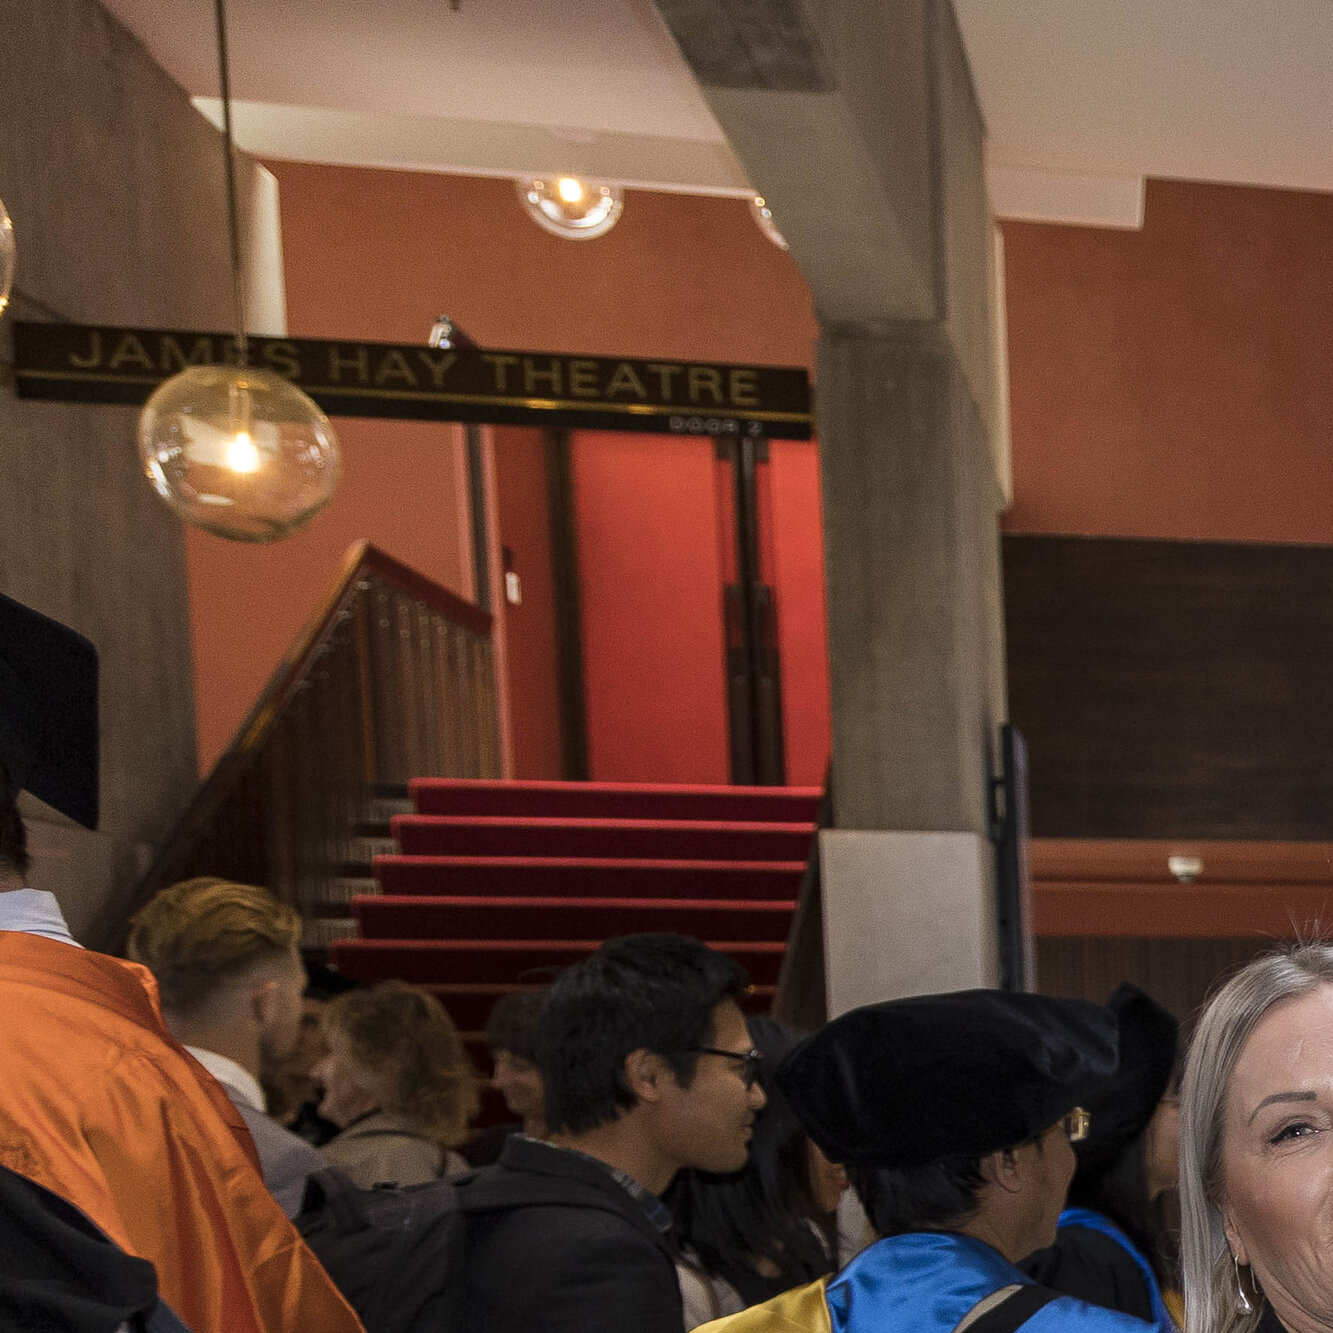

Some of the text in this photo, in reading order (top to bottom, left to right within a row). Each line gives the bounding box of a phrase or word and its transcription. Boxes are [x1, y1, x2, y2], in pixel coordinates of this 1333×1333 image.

[68, 332, 761, 406] JAMES HAY THEATRE
[669, 415, 763, 437] DOOR 2
